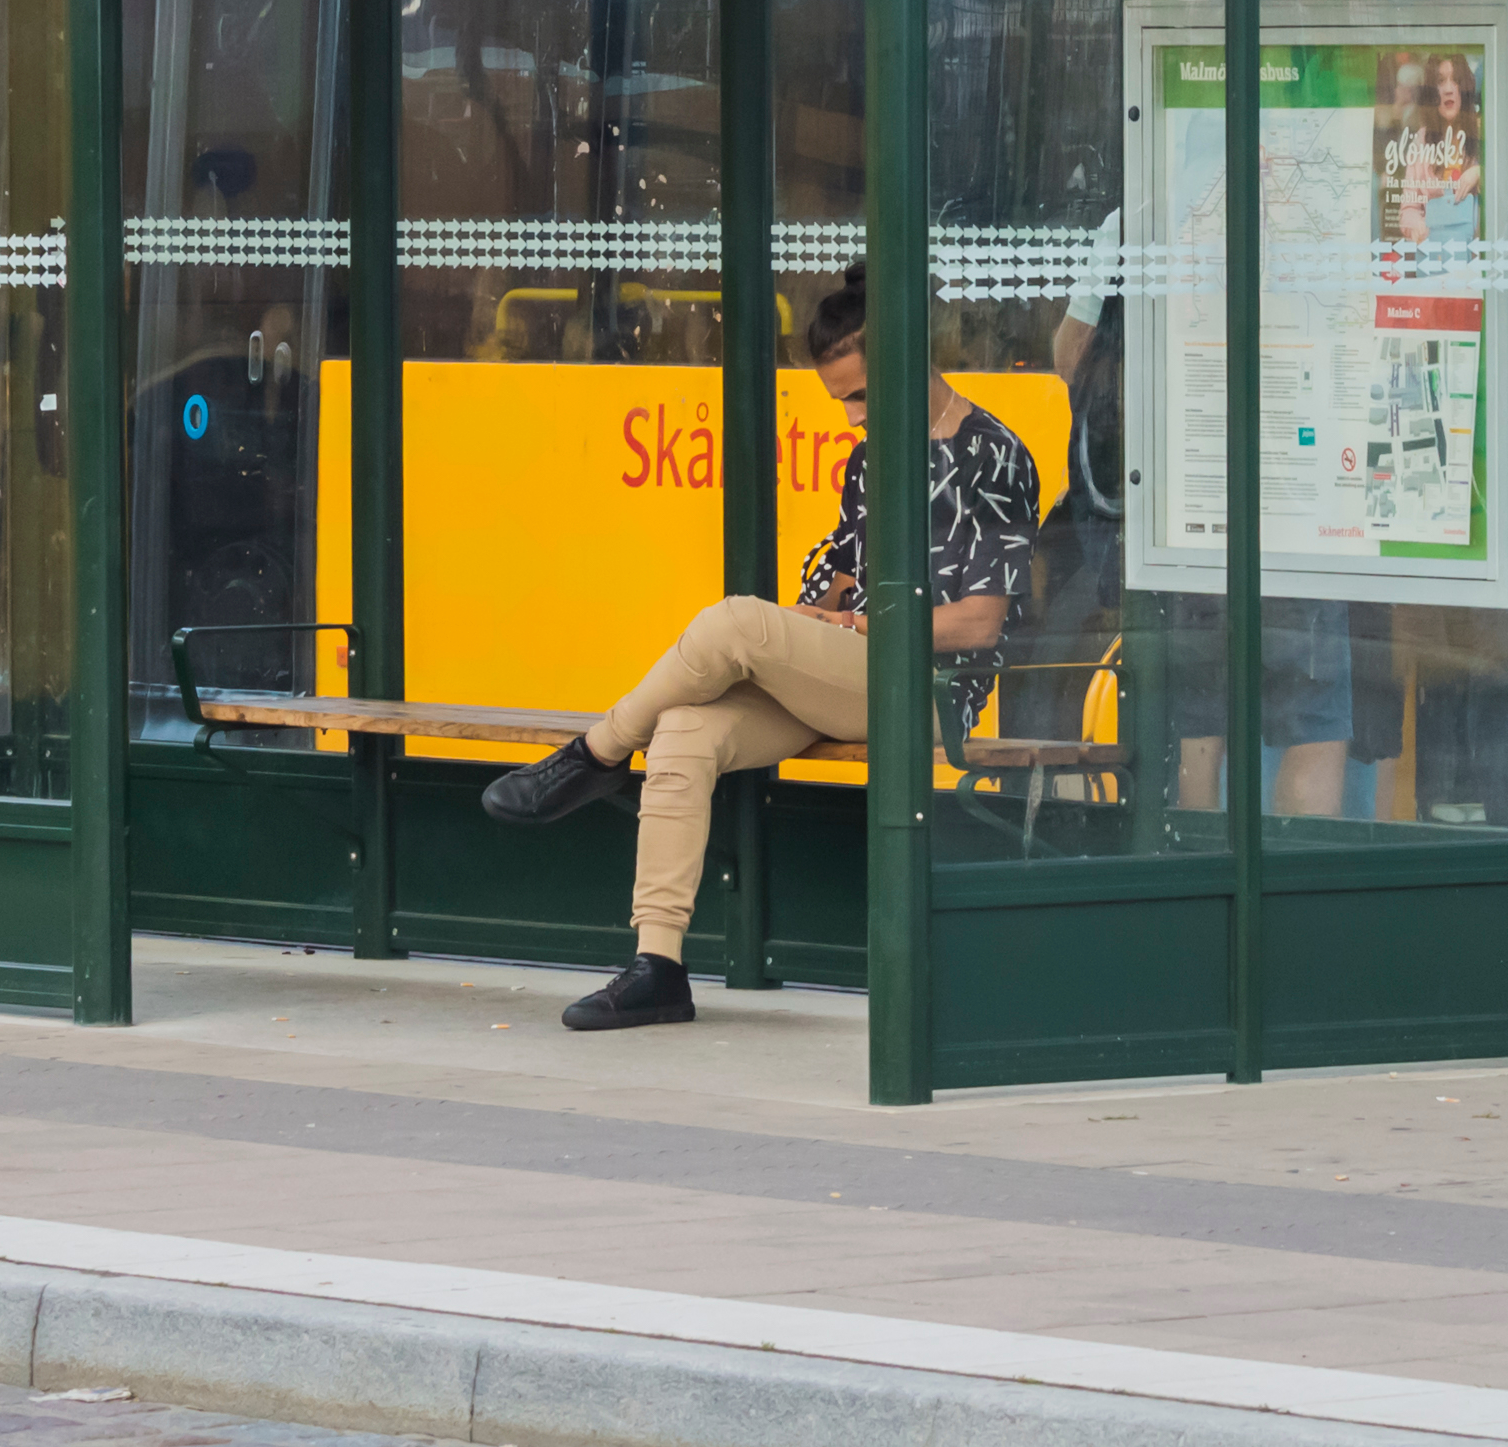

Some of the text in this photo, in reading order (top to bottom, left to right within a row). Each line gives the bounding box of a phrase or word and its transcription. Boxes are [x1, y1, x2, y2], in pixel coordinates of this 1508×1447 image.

[1384, 125, 1467, 175] glömsk?
[1386, 176, 1399, 188] Ha
[1385, 190, 1428, 203] i mobilen
[1387, 307, 1421, 319] Malmö C
